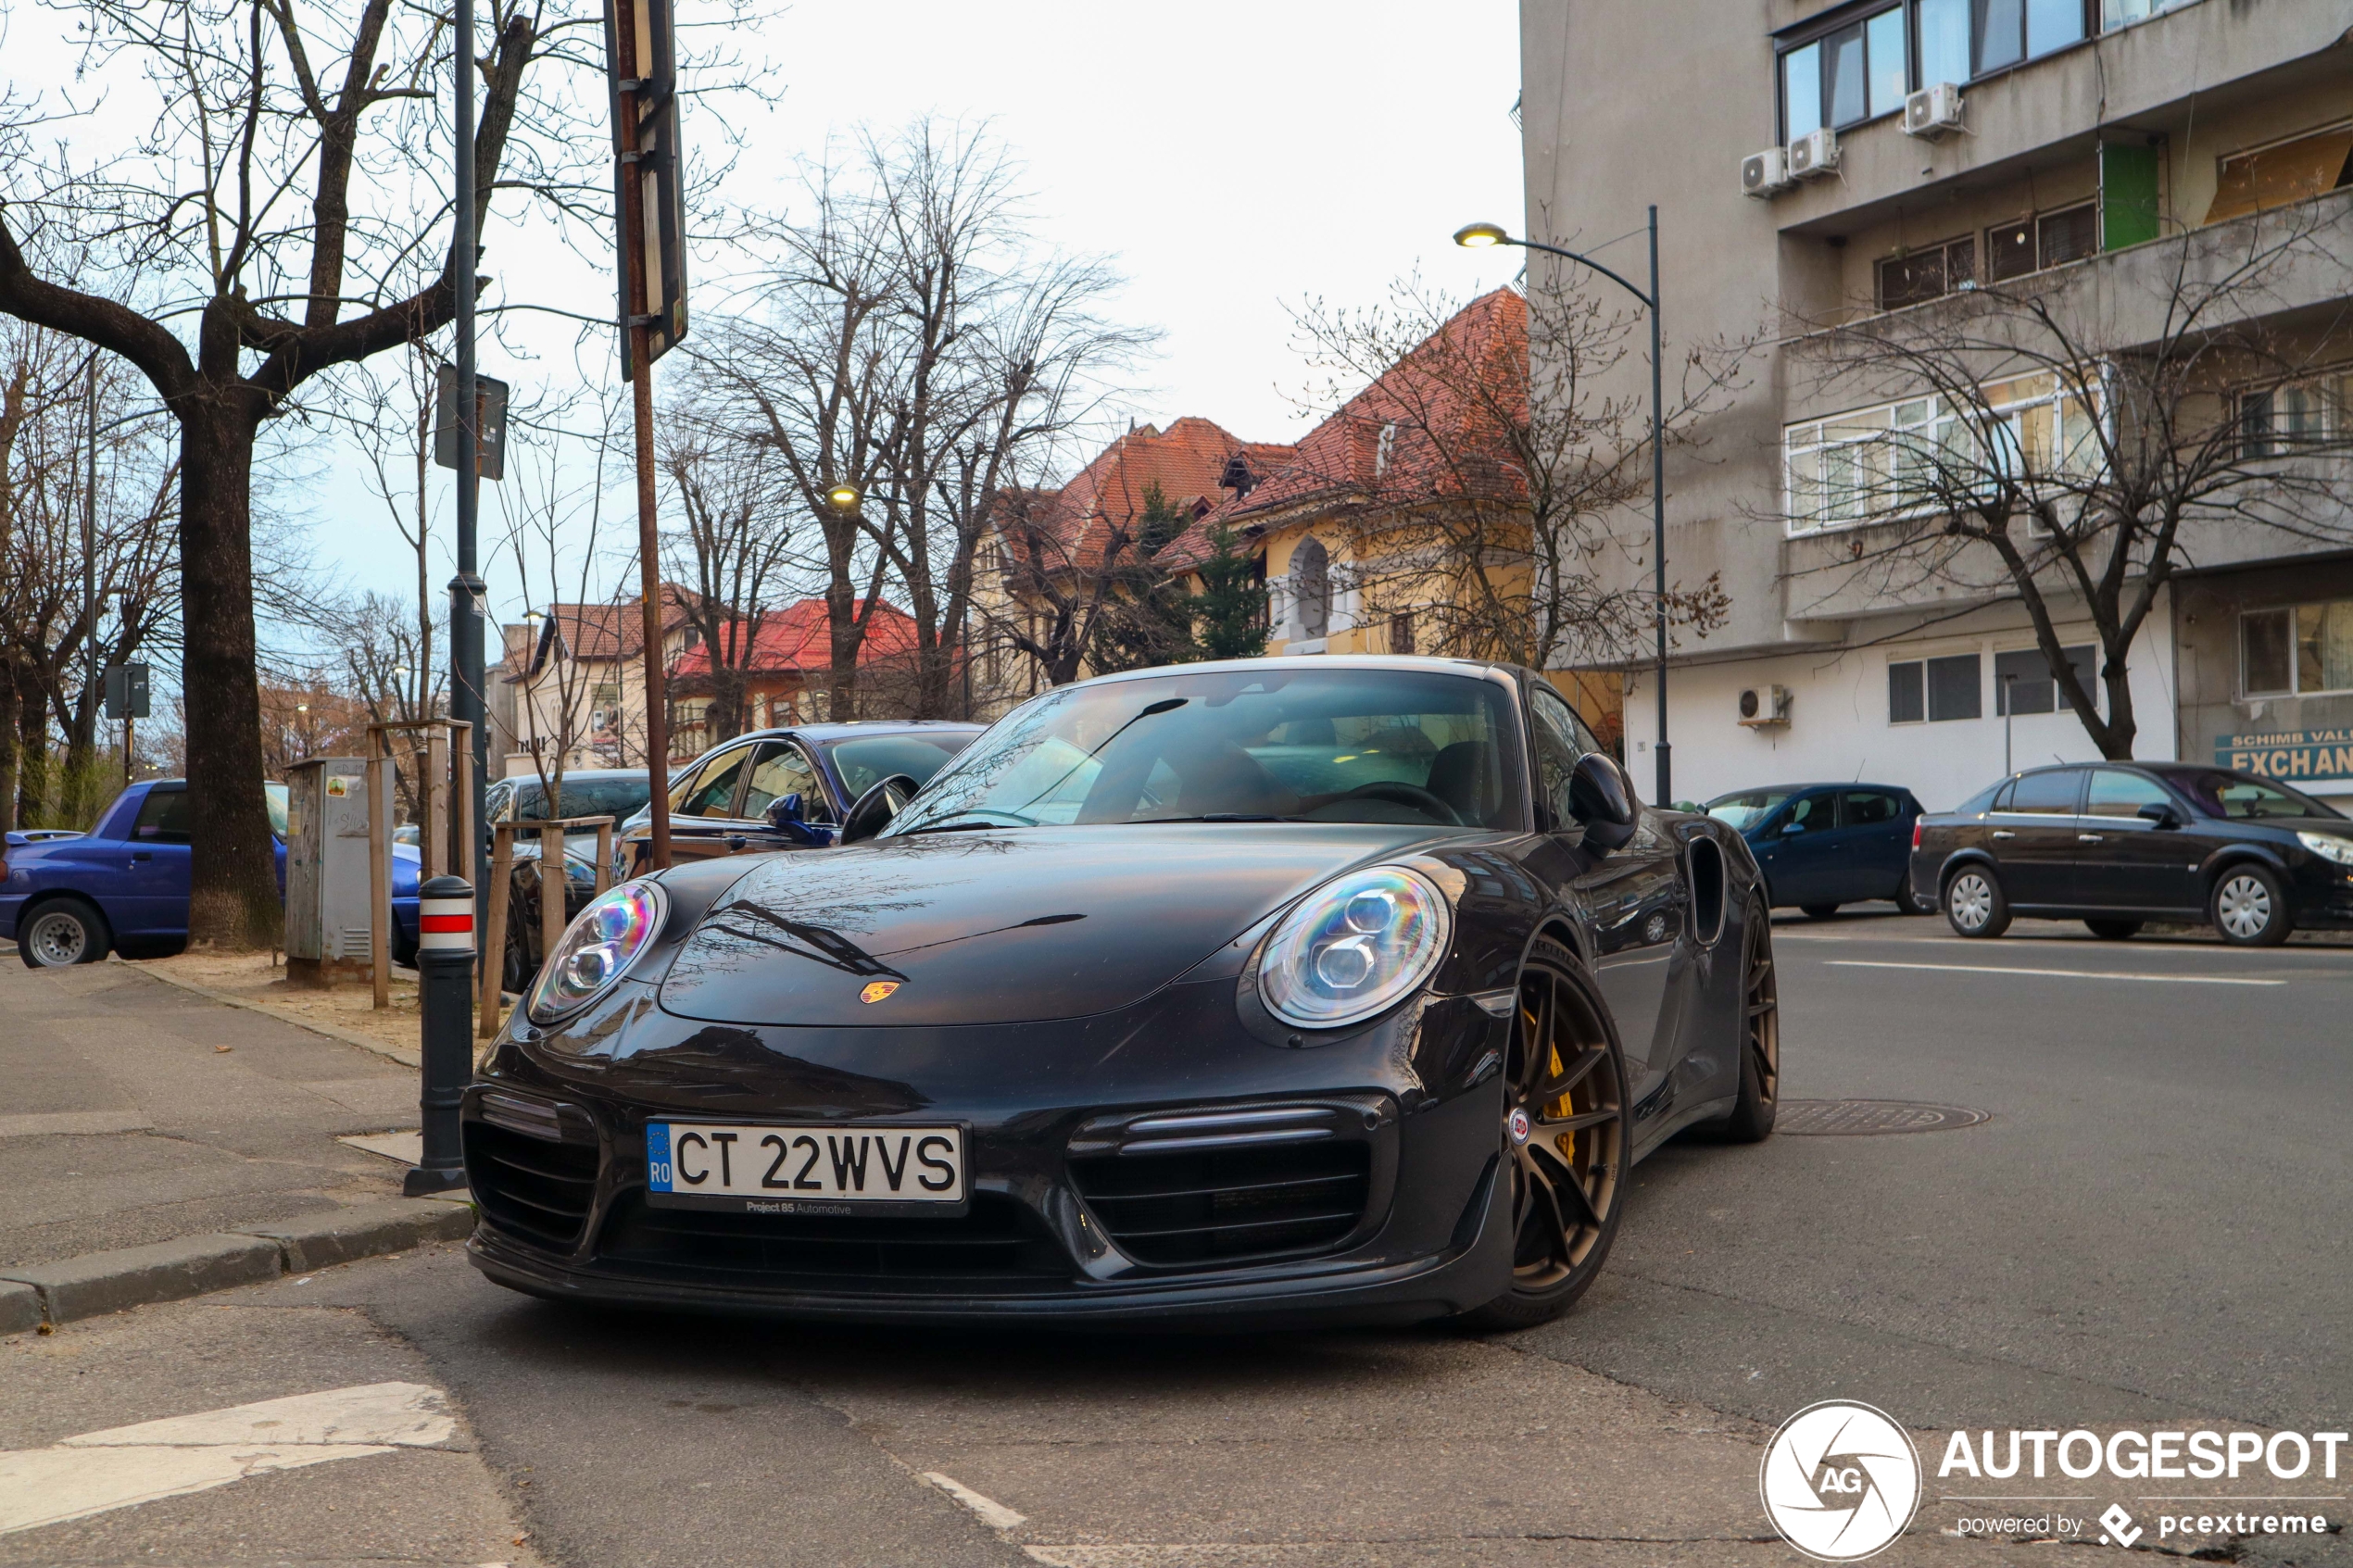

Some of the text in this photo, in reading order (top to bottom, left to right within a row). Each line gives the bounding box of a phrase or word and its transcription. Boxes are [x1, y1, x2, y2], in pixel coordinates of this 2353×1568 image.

[2232, 733, 2304, 746] SCHIMB
[676, 1132, 956, 1192] CT 22WVS
[651, 1161, 671, 1184] RO
[746, 1201, 851, 1215] Project 85 Automotive
